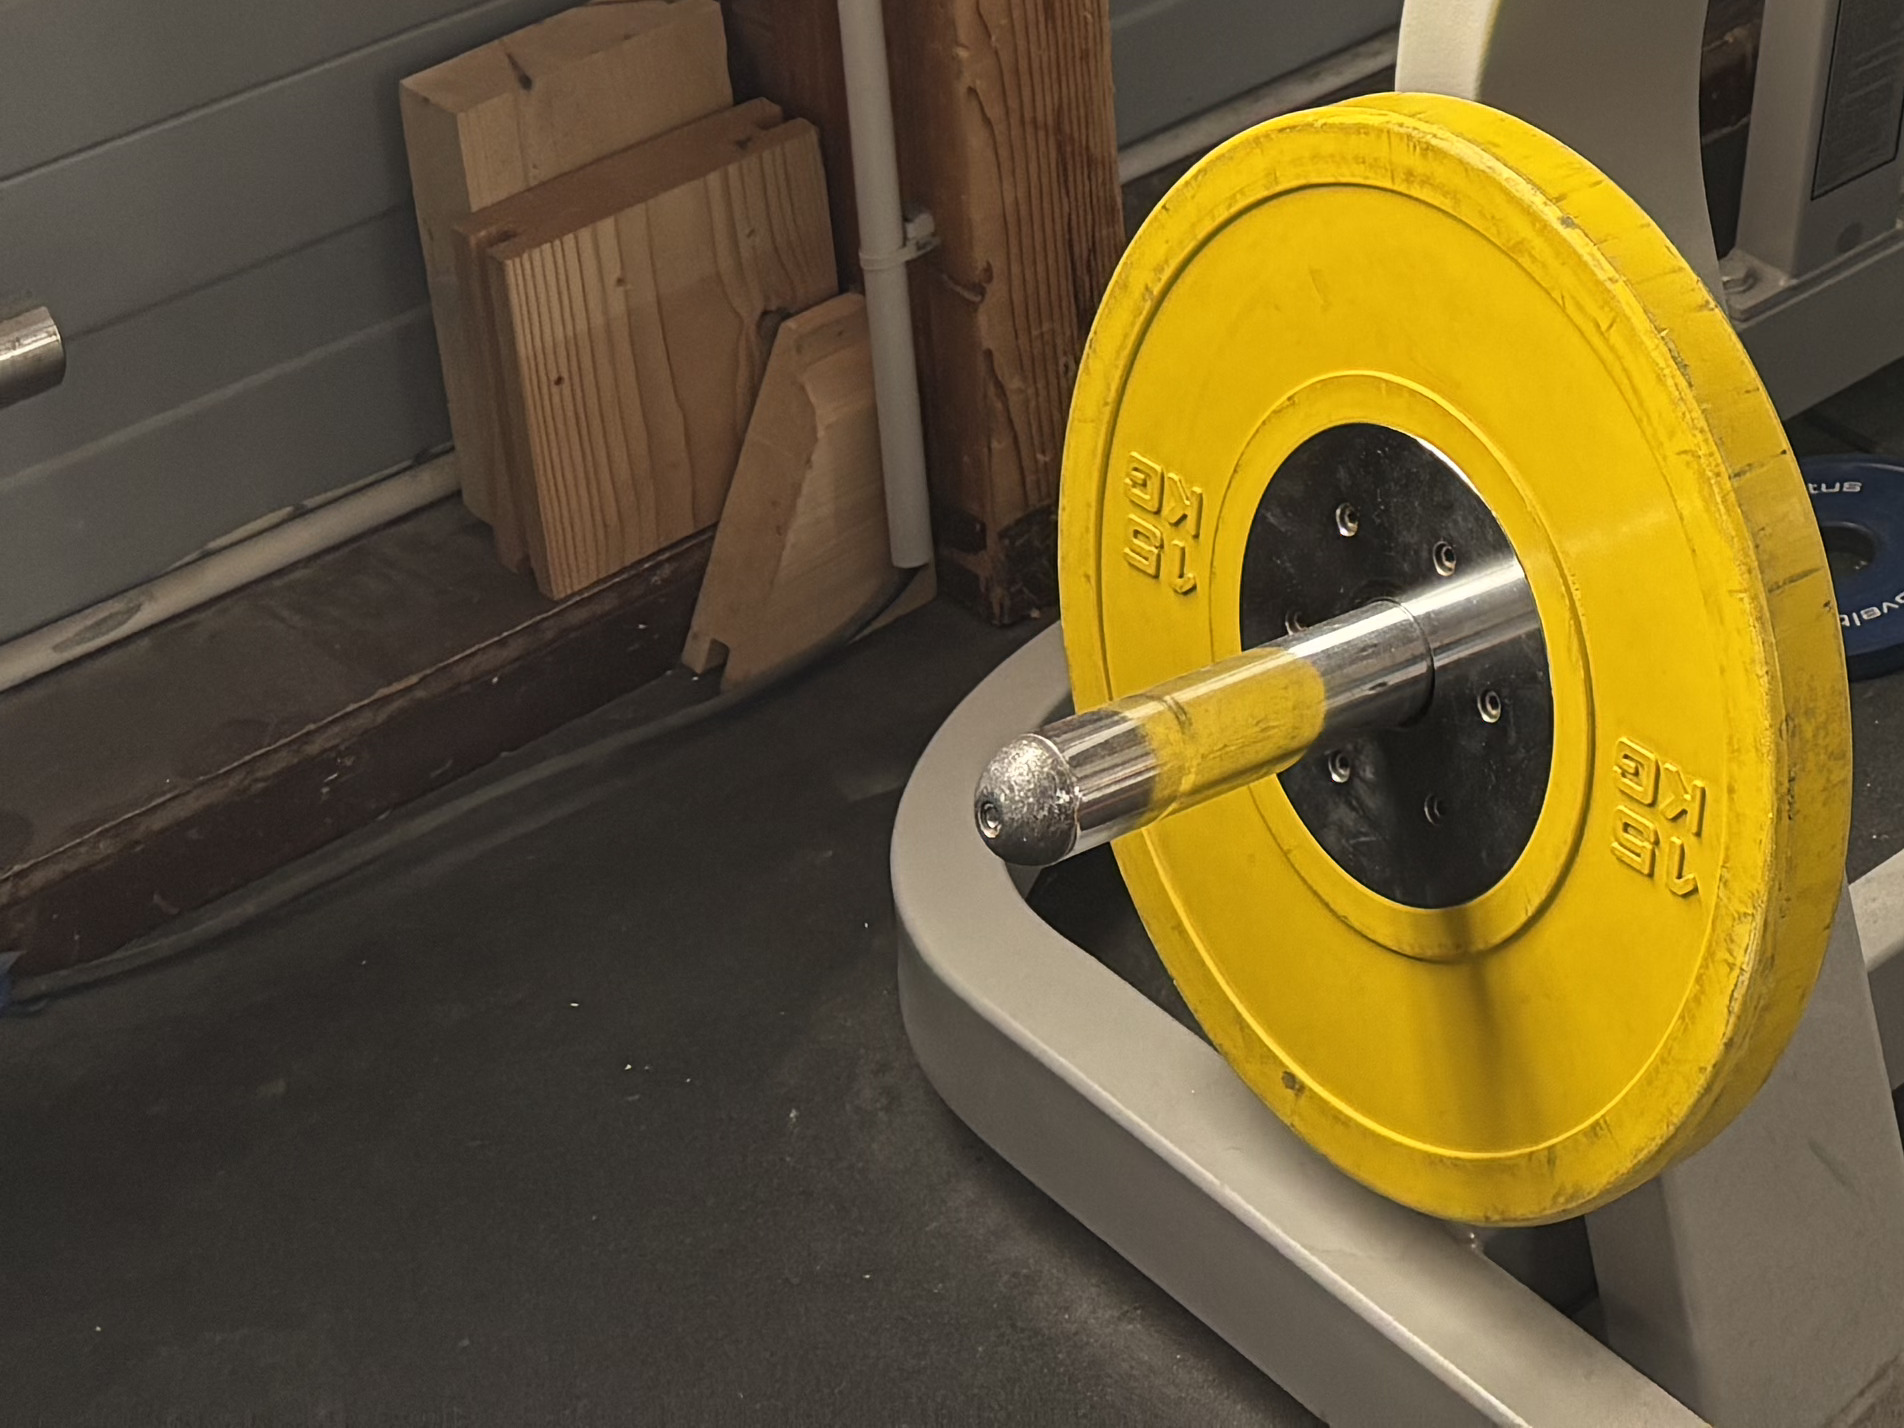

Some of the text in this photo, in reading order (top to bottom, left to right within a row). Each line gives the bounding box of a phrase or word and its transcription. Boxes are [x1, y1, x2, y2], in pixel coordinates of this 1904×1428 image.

[1123, 450, 1204, 540] KG
[1122, 513, 1199, 597] 15
[1610, 736, 1707, 838] KG
[1609, 804, 1700, 897] 15
